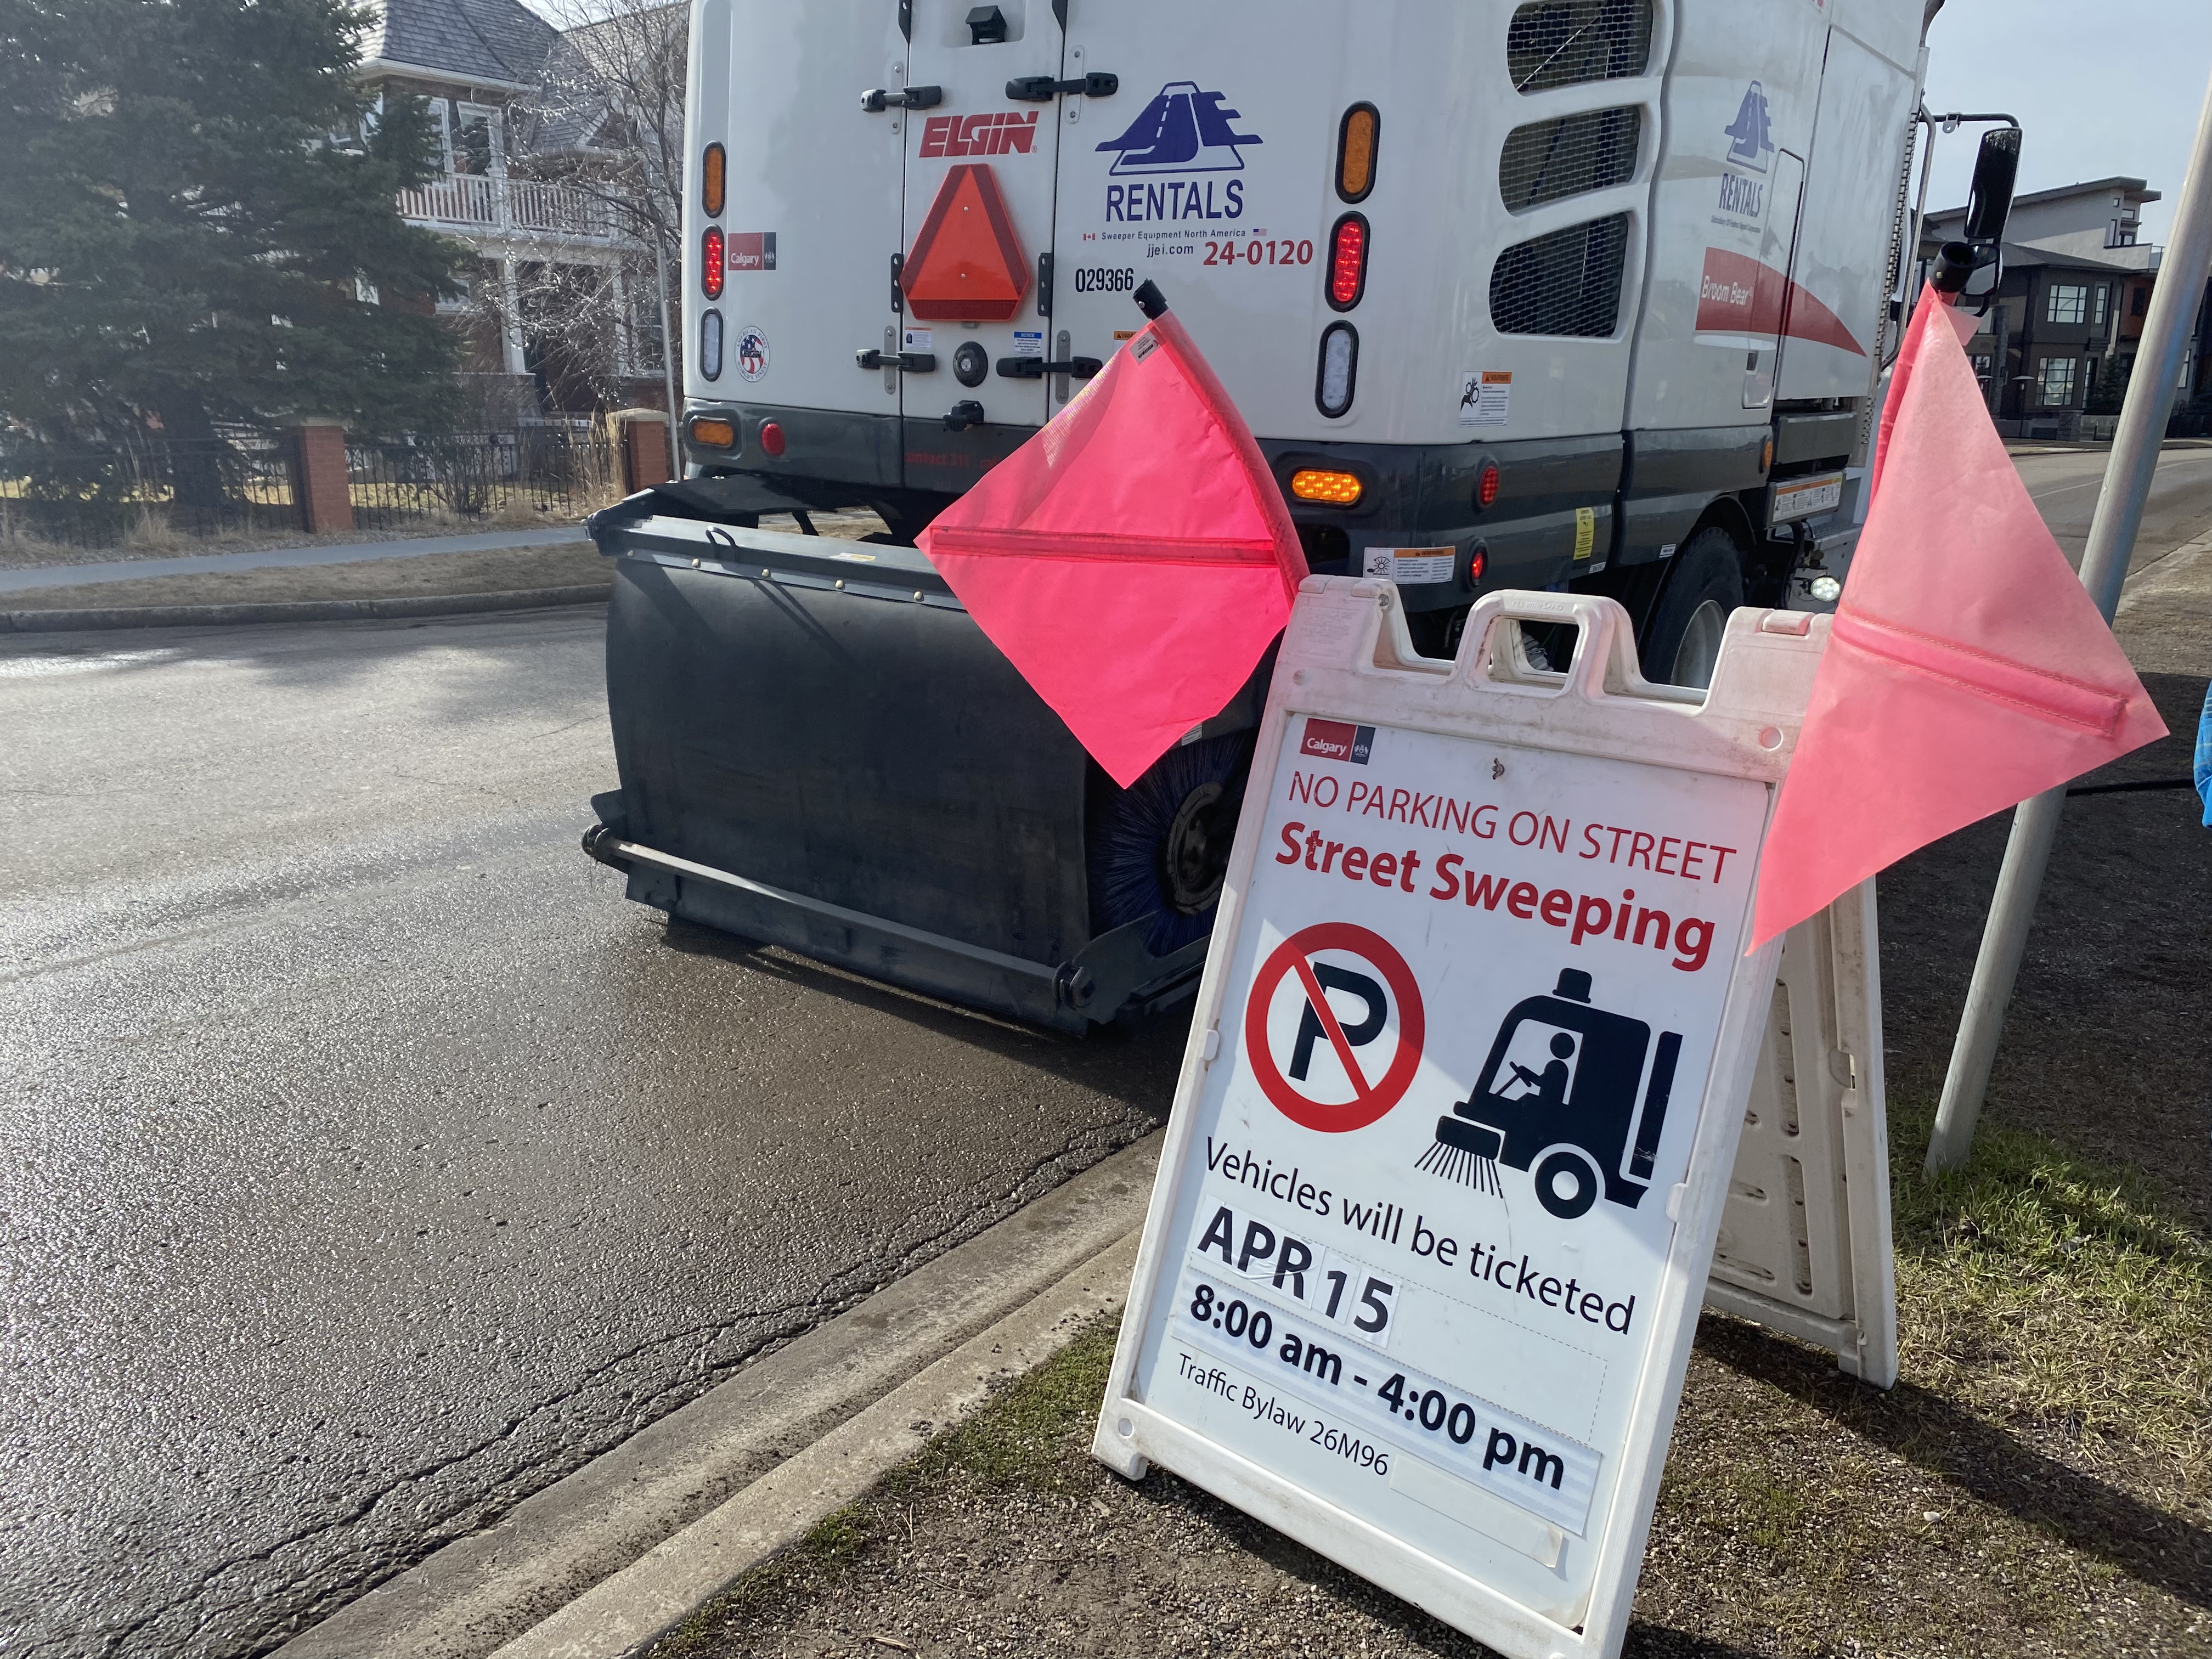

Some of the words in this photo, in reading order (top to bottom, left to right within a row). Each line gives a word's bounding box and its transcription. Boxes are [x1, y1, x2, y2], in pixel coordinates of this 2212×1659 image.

[919, 111, 1039, 157] ELGIN
[1106, 179, 1244, 222] RENTALS
[1719, 173, 1763, 218] RENTALS
[1102, 232, 1135, 241] Sweeper
[1137, 231, 1181, 240] Equipment
[1184, 229, 1207, 239] North
[1210, 228, 1246, 238] America
[1147, 244, 1194, 258] jjei.com
[1203, 240, 1313, 266] 24-0120
[731, 252, 759, 266] Calgary
[1075, 268, 1134, 292] 029366
[1701, 275, 1730, 302] Broom
[1730, 281, 1749, 306] Bear
[1306, 737, 1347, 757] Calgary
[1289, 771, 1339, 808] NO
[1346, 781, 1499, 839] PARKING
[1508, 811, 1571, 854] ON
[1578, 823, 1737, 884] STREET
[1276, 821, 1421, 893] Street
[1429, 853, 1716, 972] Sweeping
[1207, 1136, 1333, 1216] Vehicles
[1342, 1198, 1404, 1245] will
[1410, 1214, 1458, 1267] be
[1470, 1242, 1636, 1336] ticketed
[1197, 1205, 1312, 1301] APR
[1325, 1269, 1394, 1333] 15
[1190, 1283, 1273, 1349] 8:00
[1279, 1333, 1342, 1386] am
[1377, 1372, 1476, 1445] 4:00
[1482, 1426, 1564, 1491] pm
[1179, 1352, 1238, 1403] Traffic
[1242, 1385, 1306, 1435] Bylaw
[1309, 1420, 1389, 1476] 26M96
